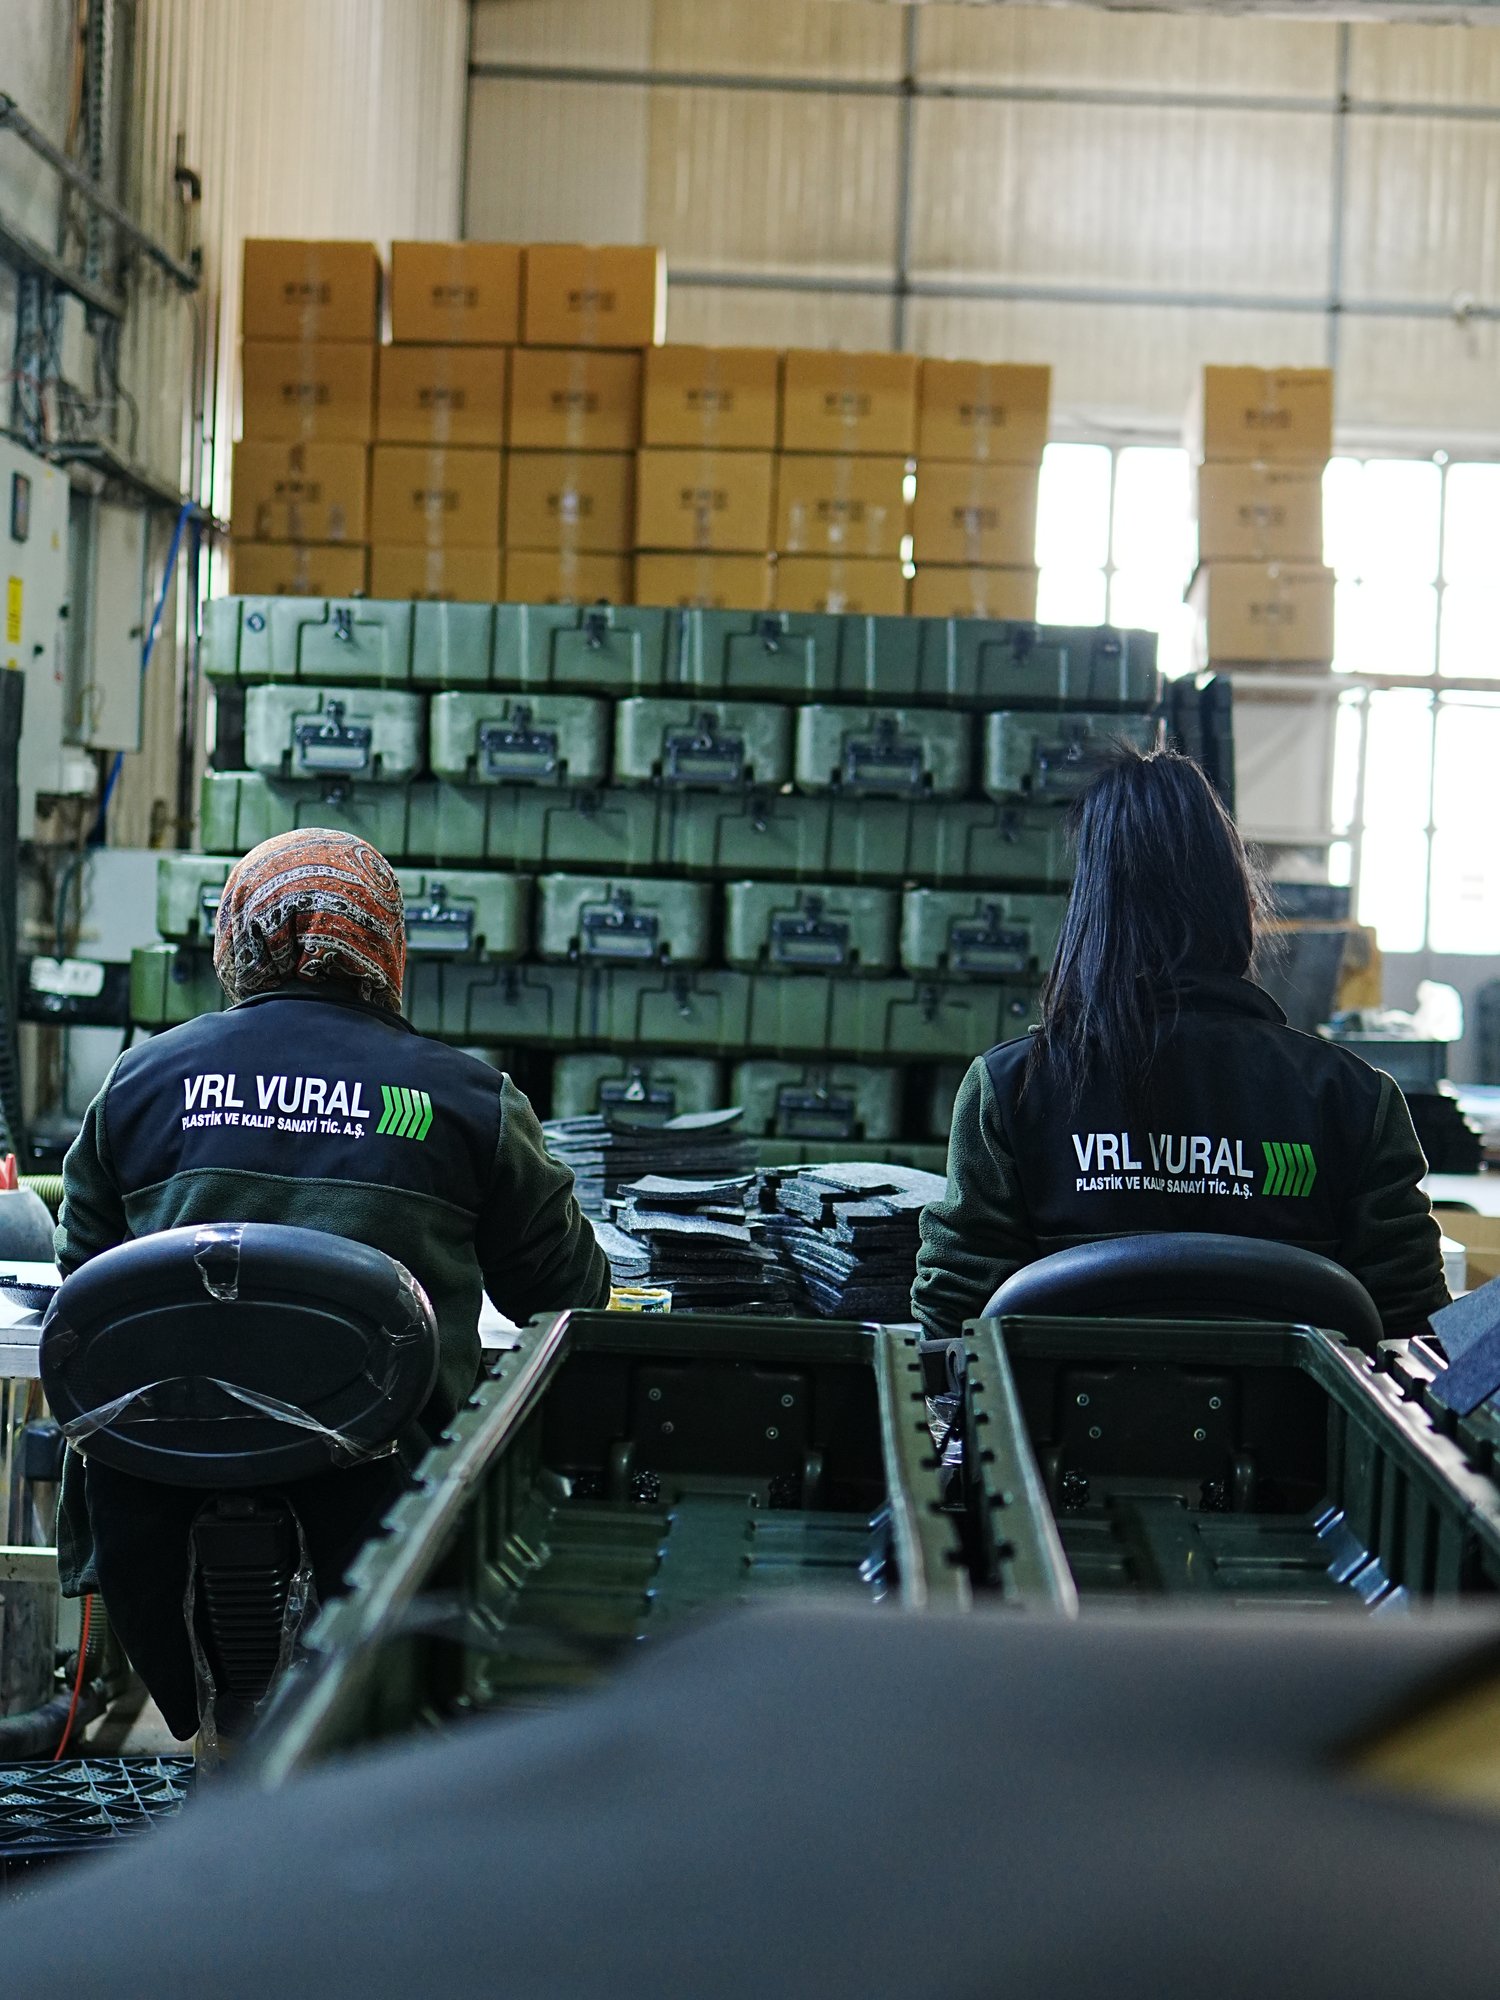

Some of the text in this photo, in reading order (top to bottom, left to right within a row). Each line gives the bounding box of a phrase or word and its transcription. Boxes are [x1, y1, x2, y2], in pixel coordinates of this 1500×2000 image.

[184, 1074, 370, 1118] VRL VURAL
[182, 1111, 365, 1139] PLASTİK VE KALIP SANAYİ TİC. A.Ş.
[1072, 1132, 1254, 1178] VRL VURAL
[1076, 1174, 1123, 1191] PLASTİK
[1126, 1177, 1140, 1190] VE
[1167, 1178, 1205, 1194] SANAYİ
[1208, 1178, 1230, 1195] TİC.
[1232, 1183, 1253, 1200] A.Ş.
